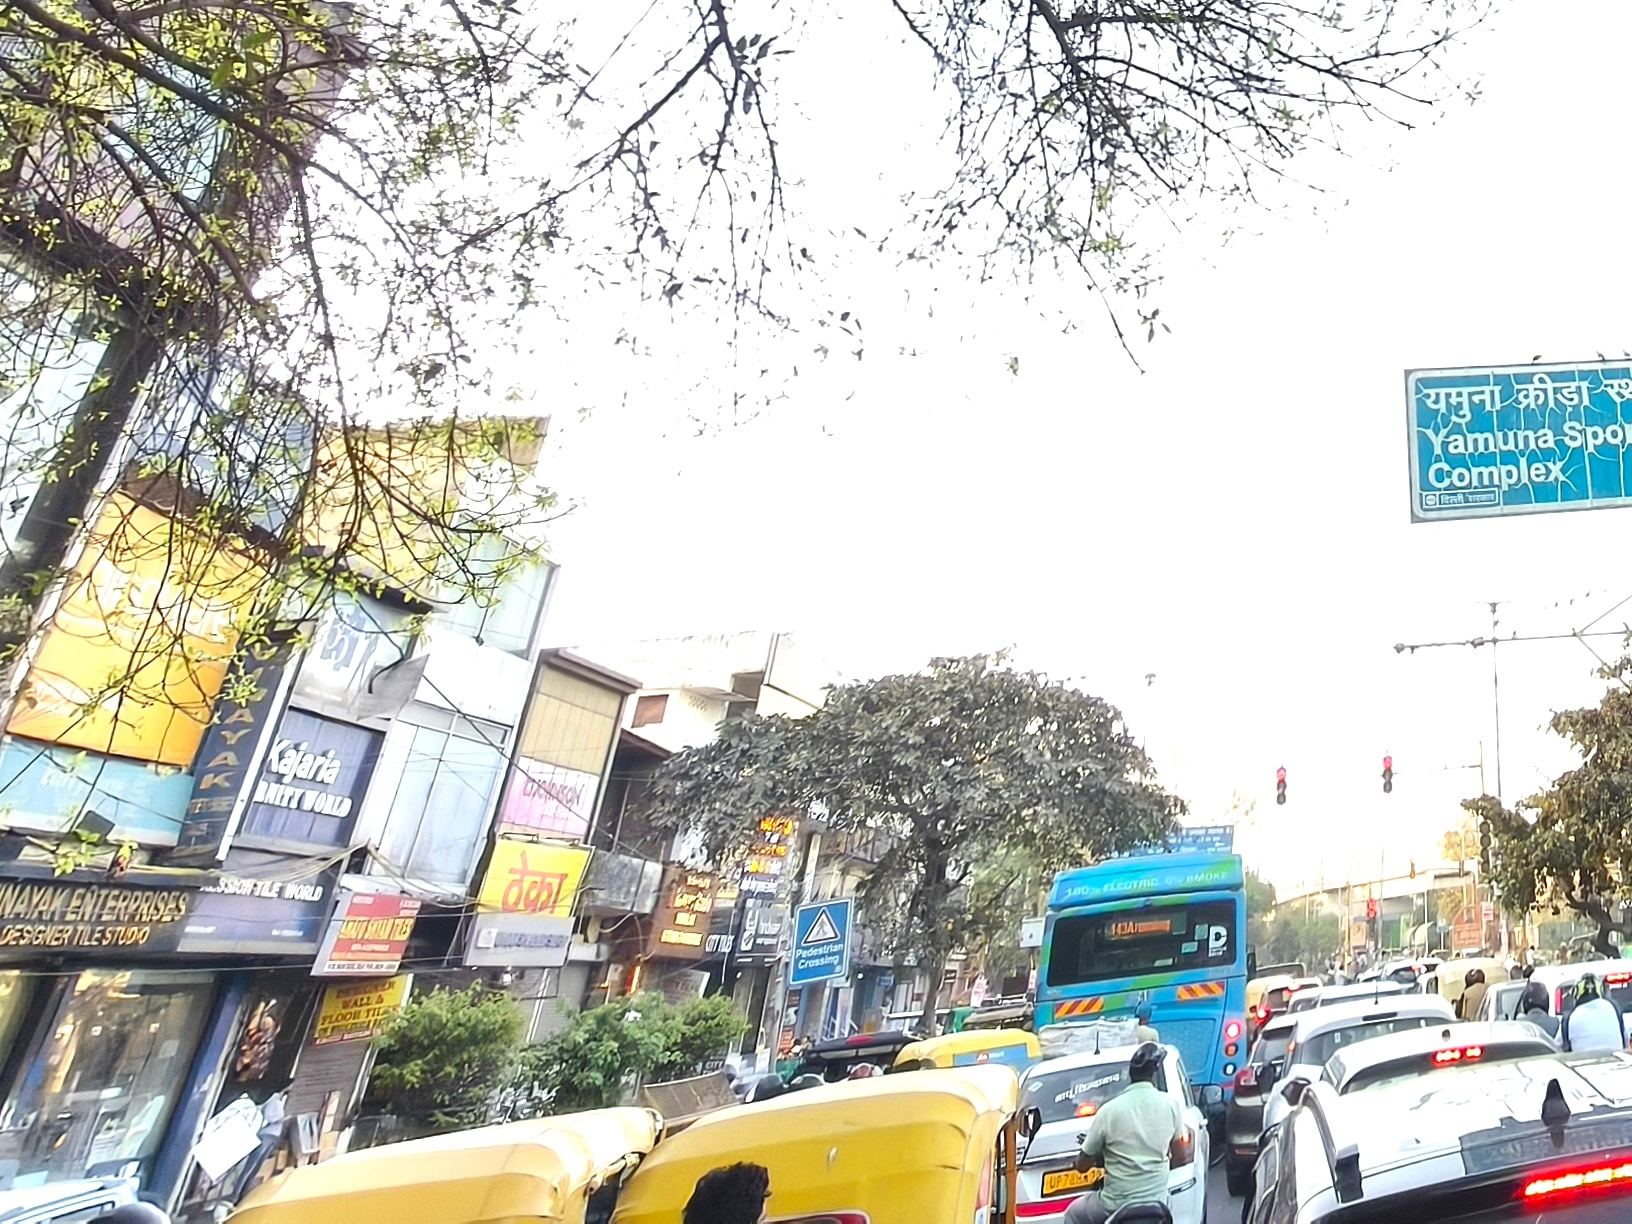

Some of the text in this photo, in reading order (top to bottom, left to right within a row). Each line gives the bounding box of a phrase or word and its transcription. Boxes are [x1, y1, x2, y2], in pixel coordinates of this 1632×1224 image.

[1421, 383, 1501, 422] यमुना
[1422, 429, 1554, 455] Yamuna
[1428, 457, 1566, 490] Complex
[266, 738, 341, 784] Kajaria
[302, 789, 353, 818] WORLD
[64, 885, 190, 922] ENTERPRISES
[284, 883, 323, 901] WORLD
[0, 924, 150, 947] DESIGNER TILE STUDIO
[795, 943, 844, 959] Pedestrian
[798, 955, 839, 969] Crossing
